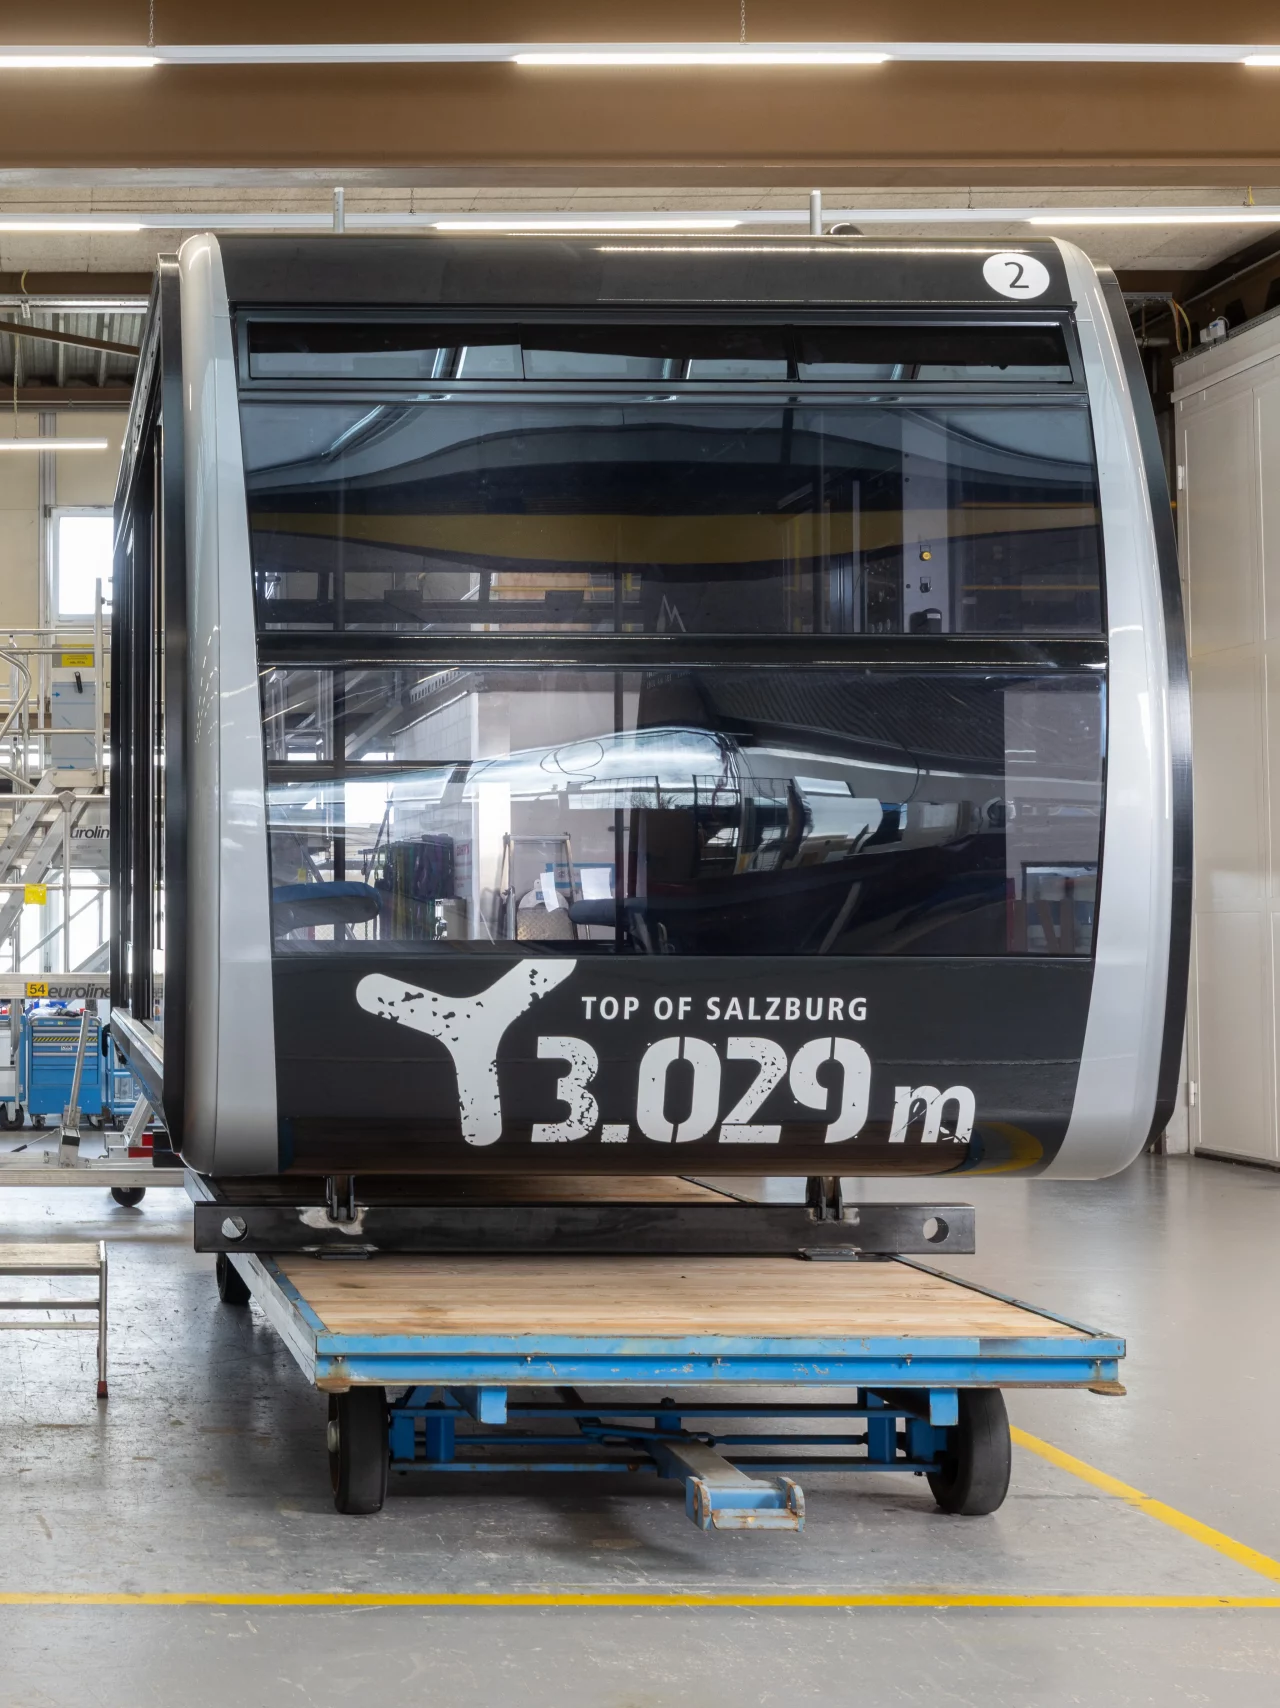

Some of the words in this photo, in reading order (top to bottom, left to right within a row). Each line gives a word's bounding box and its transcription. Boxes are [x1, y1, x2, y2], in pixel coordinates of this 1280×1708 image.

[1004, 262, 1029, 288] 2
[70, 825, 110, 839] urolin
[30, 983, 46, 995] 54
[48, 983, 111, 998] euroline
[582, 996, 639, 1020] TOP
[654, 996, 692, 1020] OF
[706, 996, 867, 1021] SALZBURG
[531, 1036, 872, 1143] 3.029
[888, 1085, 976, 1143] m
